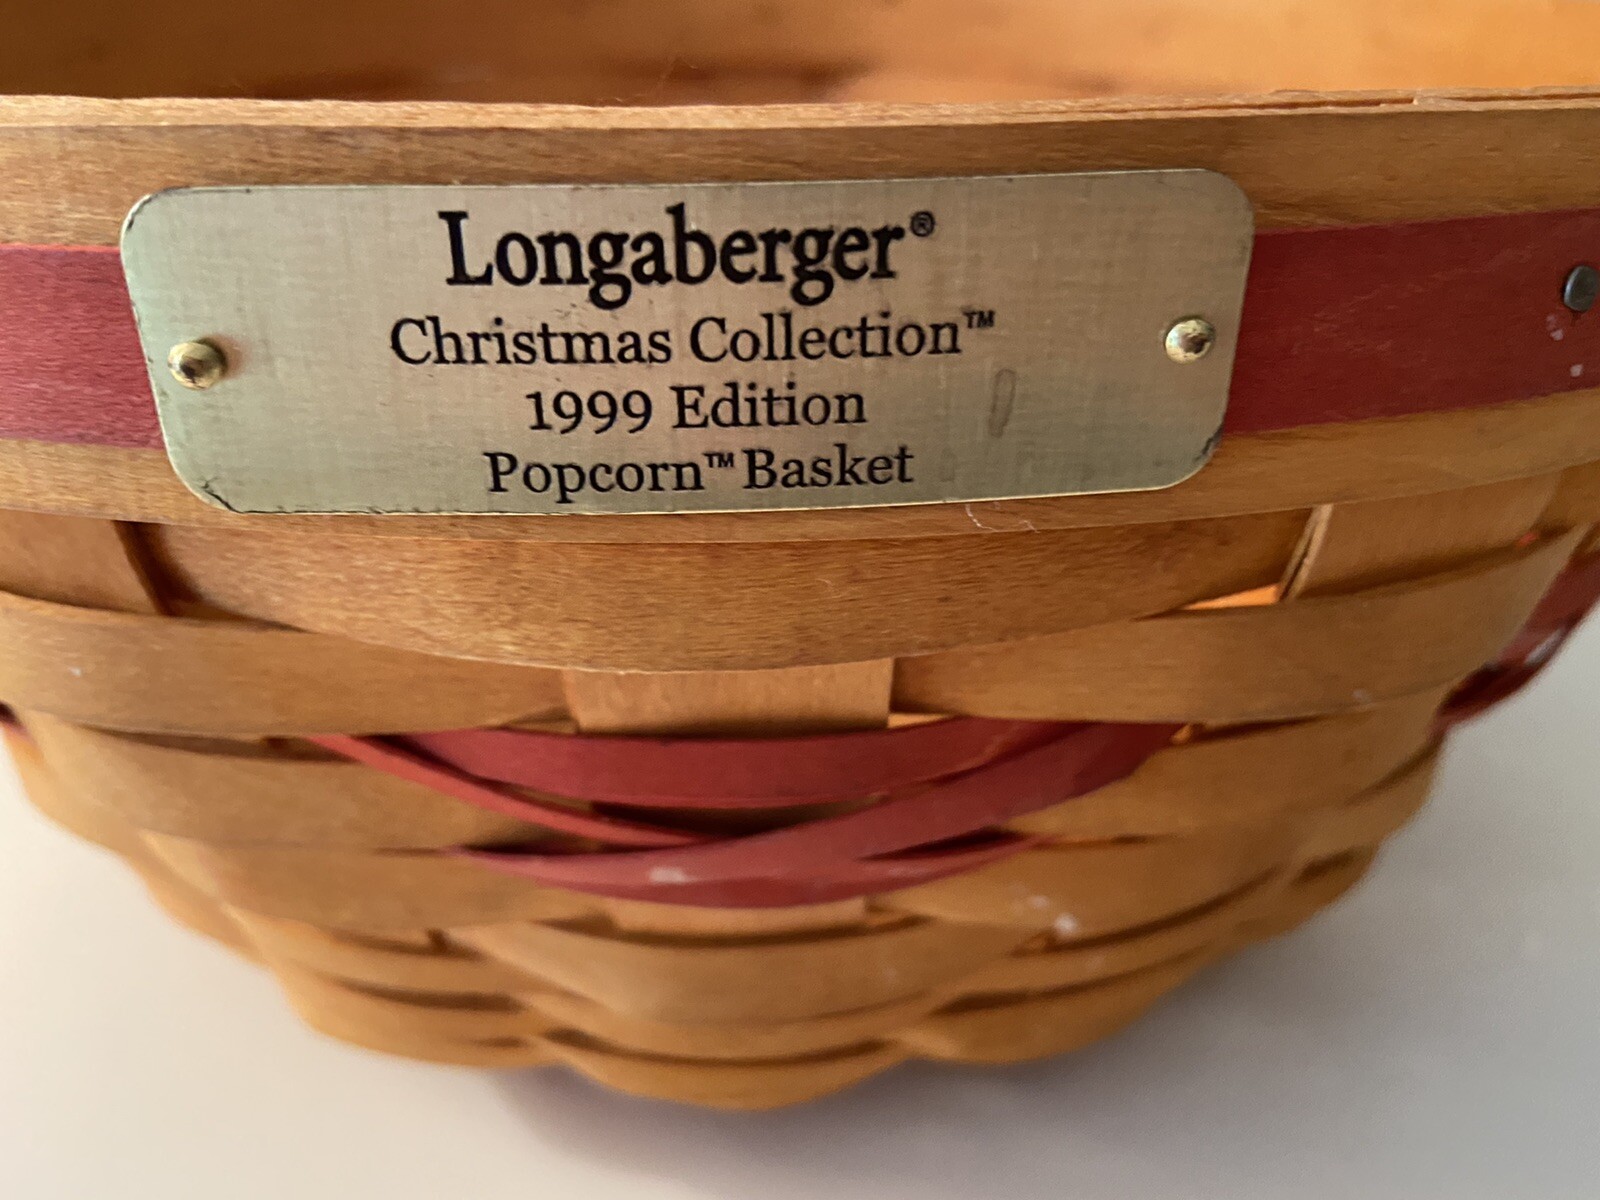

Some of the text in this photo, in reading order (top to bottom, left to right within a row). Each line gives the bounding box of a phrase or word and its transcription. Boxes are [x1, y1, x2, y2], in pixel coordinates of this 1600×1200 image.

[390, 314, 673, 367] Christmas
[525, 380, 868, 435] 1999 Edition
[741, 443, 915, 491] Basket
